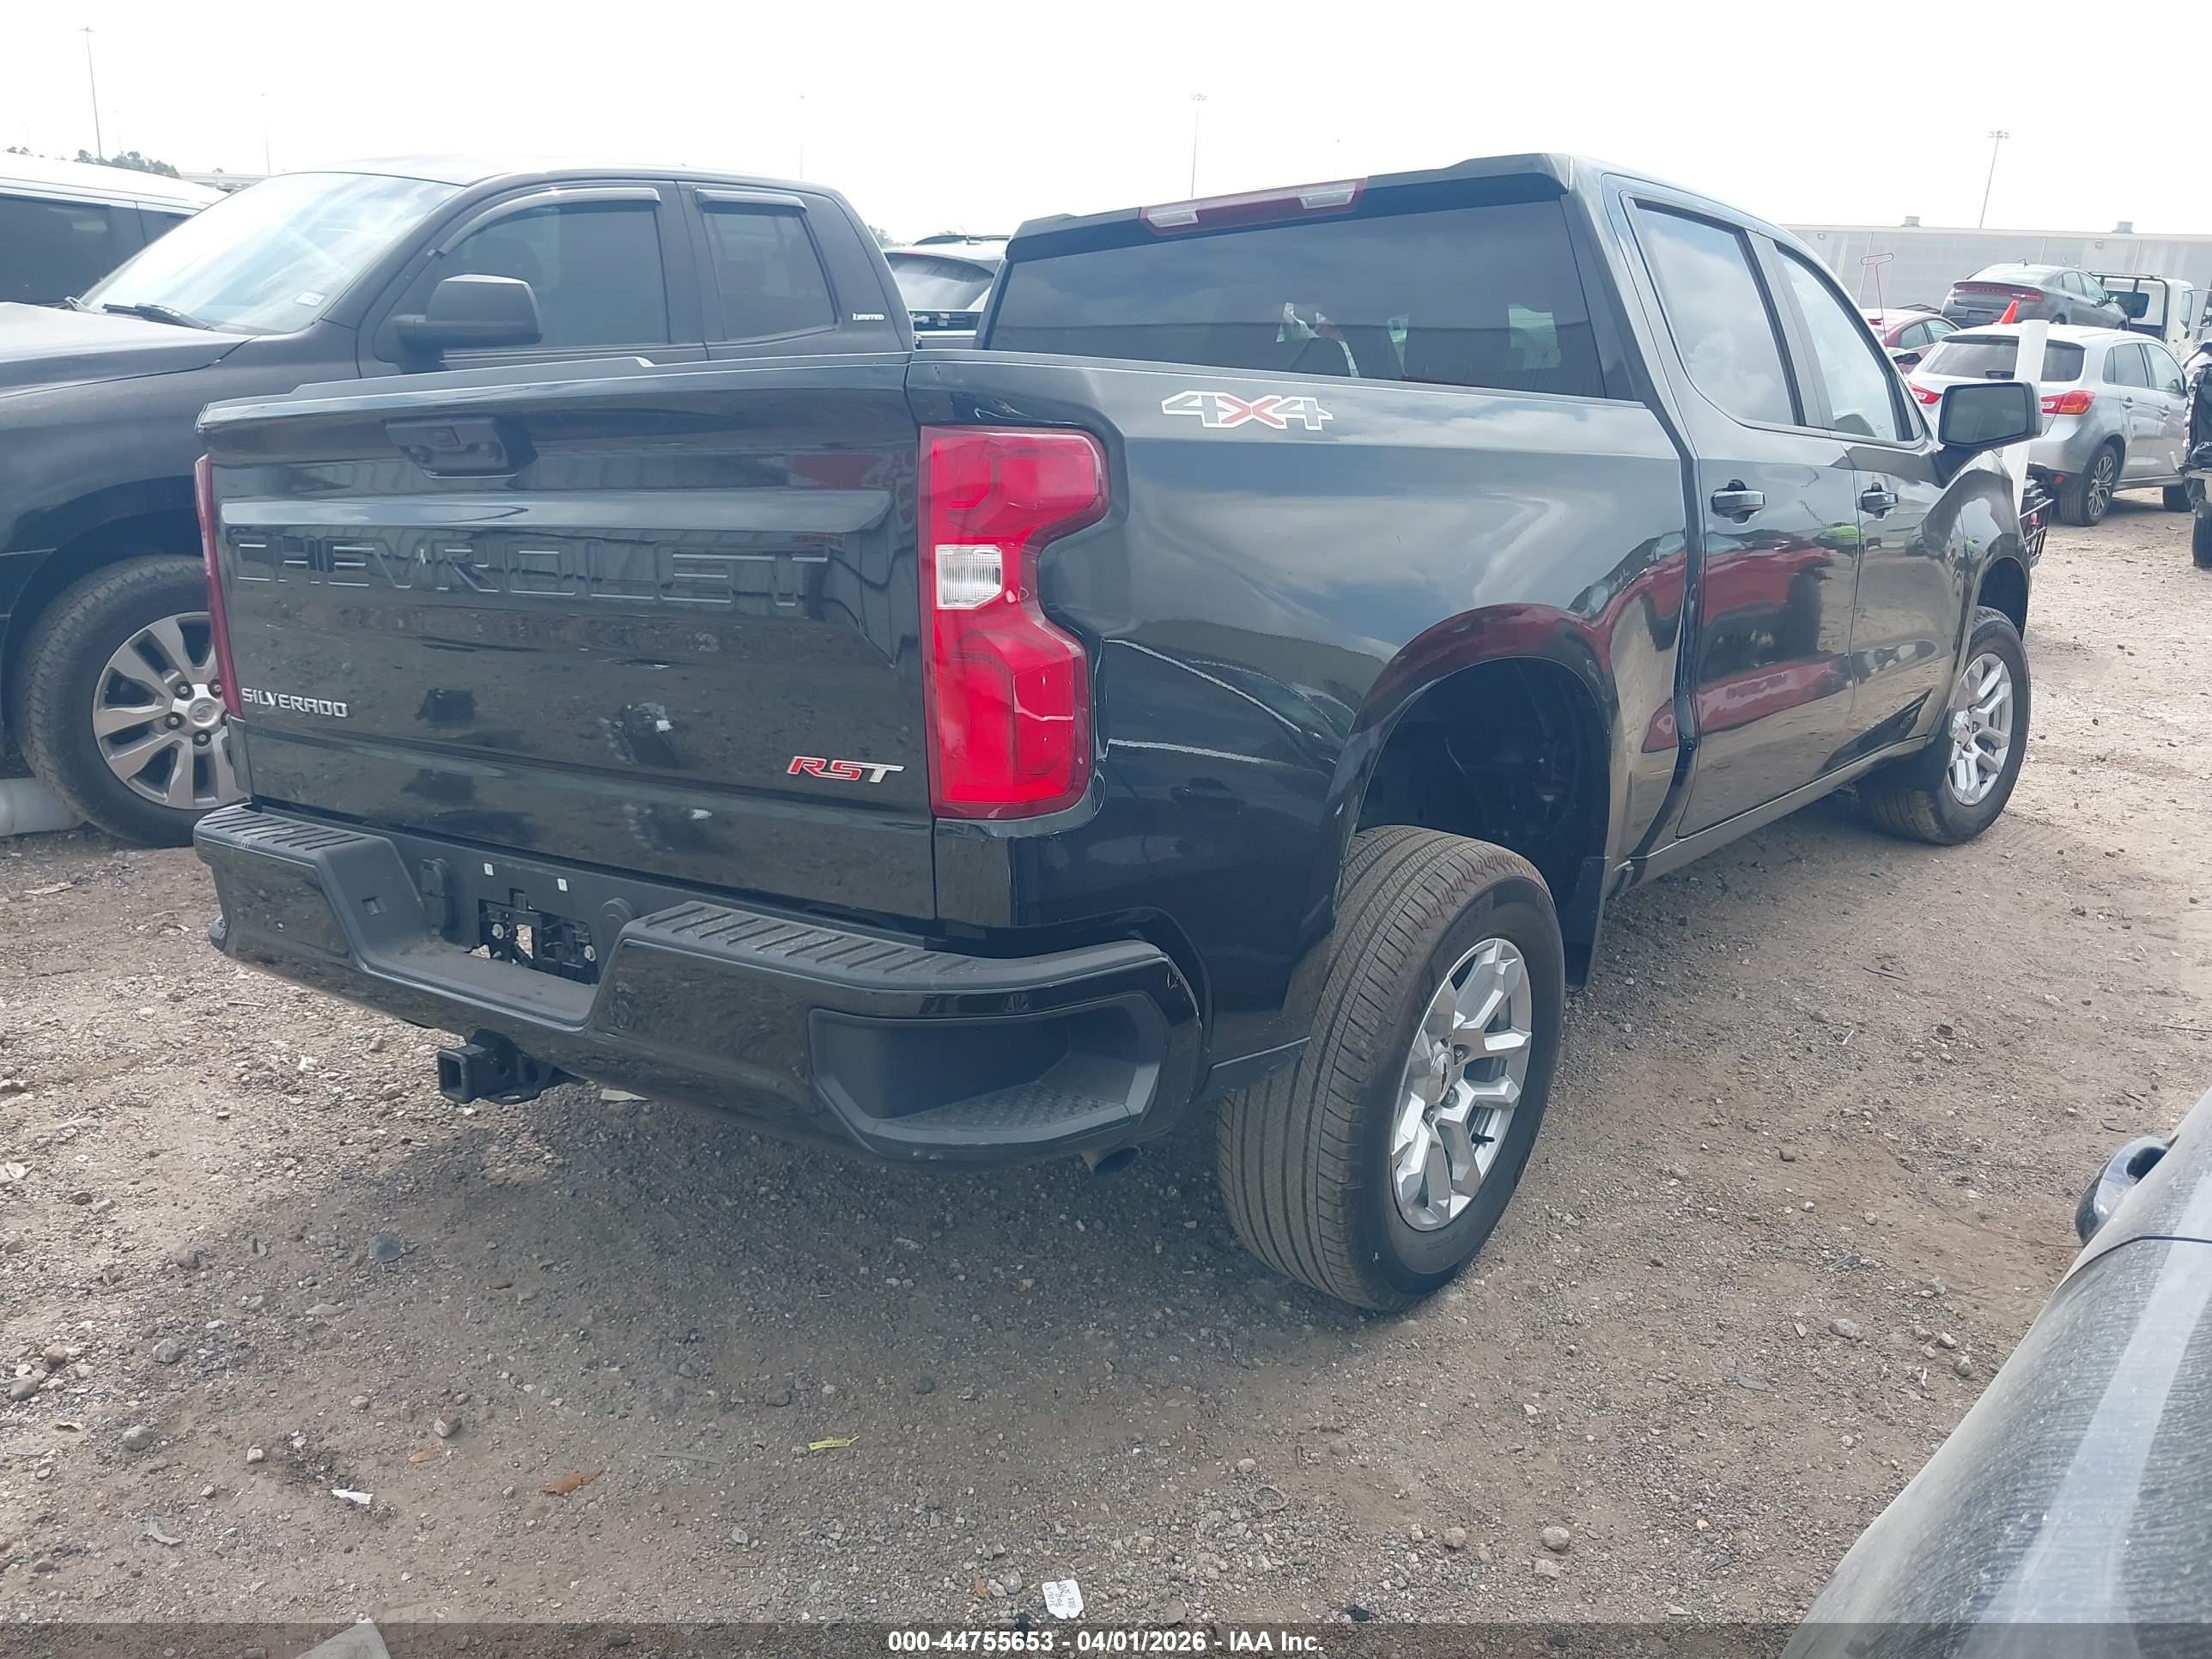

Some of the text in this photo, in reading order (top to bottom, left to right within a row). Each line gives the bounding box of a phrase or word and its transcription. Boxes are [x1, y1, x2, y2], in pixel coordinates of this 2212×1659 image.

[232, 534, 830, 607] CHEVROLET
[241, 687, 349, 718] SILVERADO
[786, 756, 906, 783] RST
